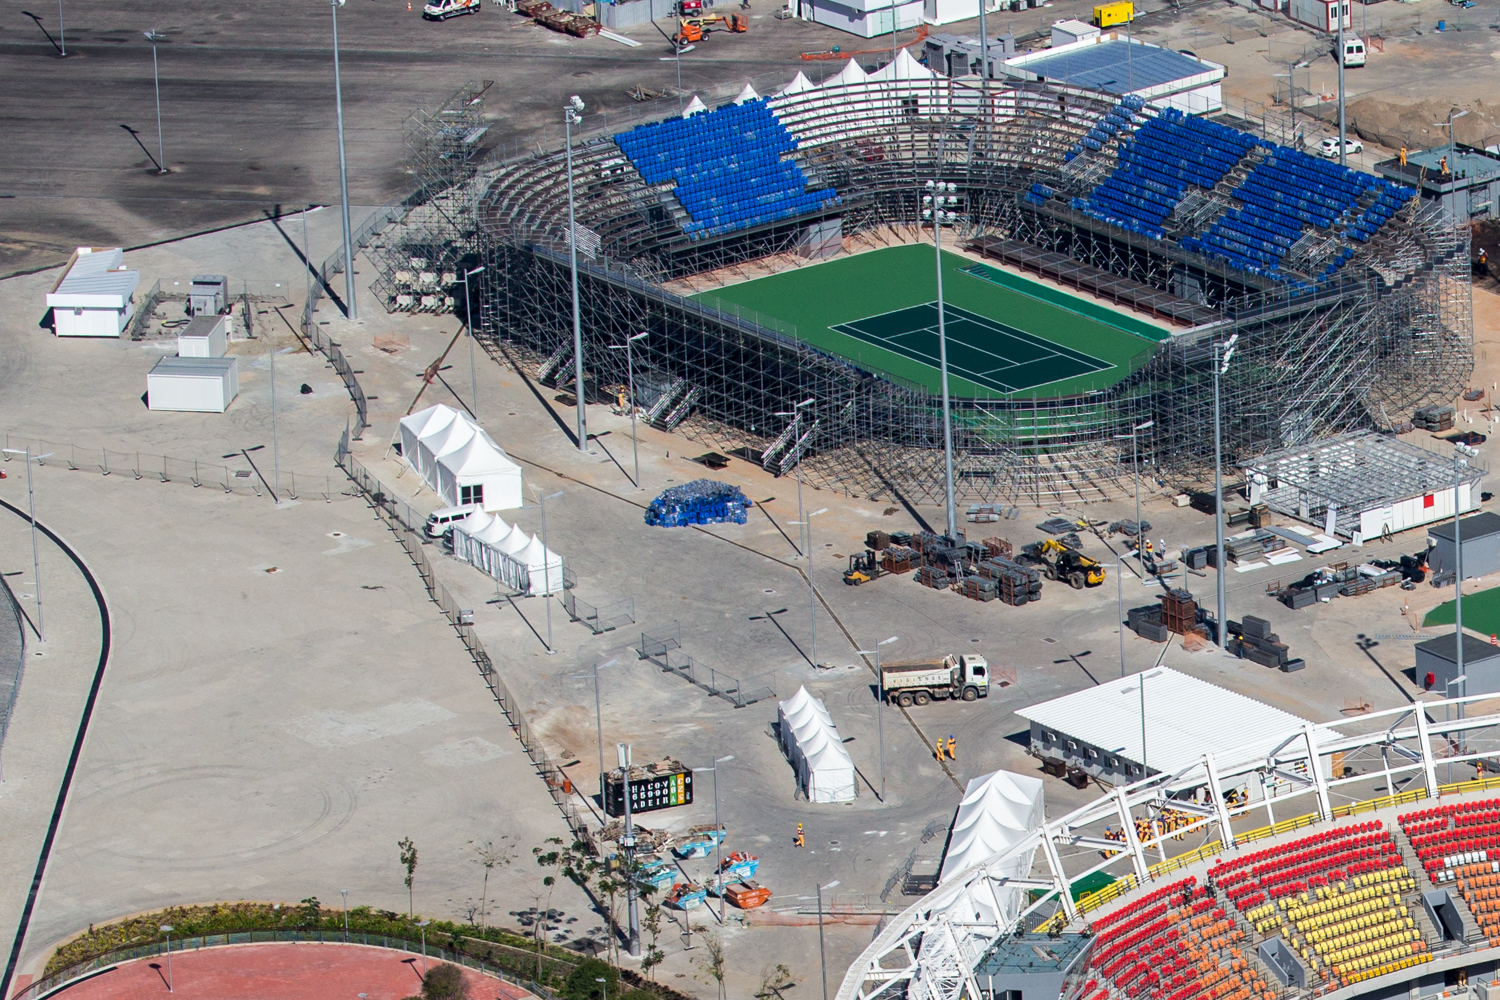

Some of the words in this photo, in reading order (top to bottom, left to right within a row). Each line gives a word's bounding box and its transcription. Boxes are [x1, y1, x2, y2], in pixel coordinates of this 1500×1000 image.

[632, 777, 691, 794] HACO-VACO
[632, 786, 685, 800] 659-9082
[632, 794, 685, 809] ADEIRAS
